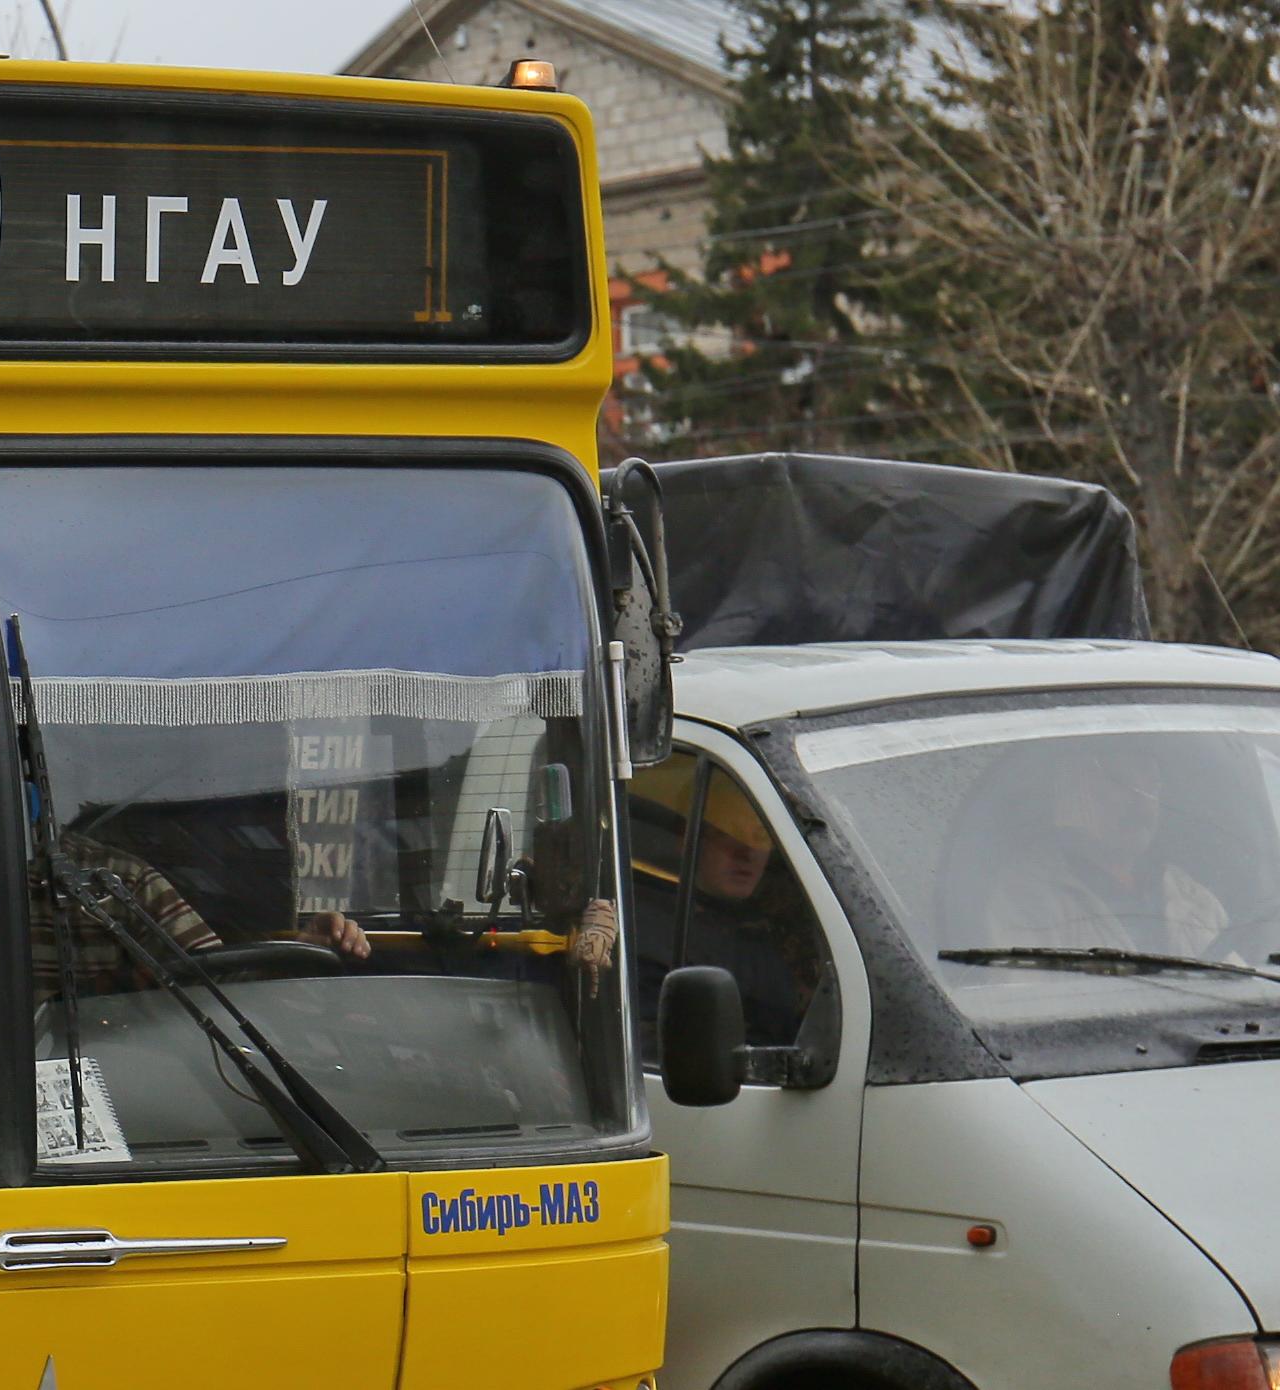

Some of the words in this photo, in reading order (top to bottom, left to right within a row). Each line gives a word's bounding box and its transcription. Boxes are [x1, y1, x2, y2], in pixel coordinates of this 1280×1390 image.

[65, 194, 328, 287] НГАУ
[293, 735, 364, 770] ЕЛИ
[421, 1180, 600, 1236] Сибирь-МАЗ
